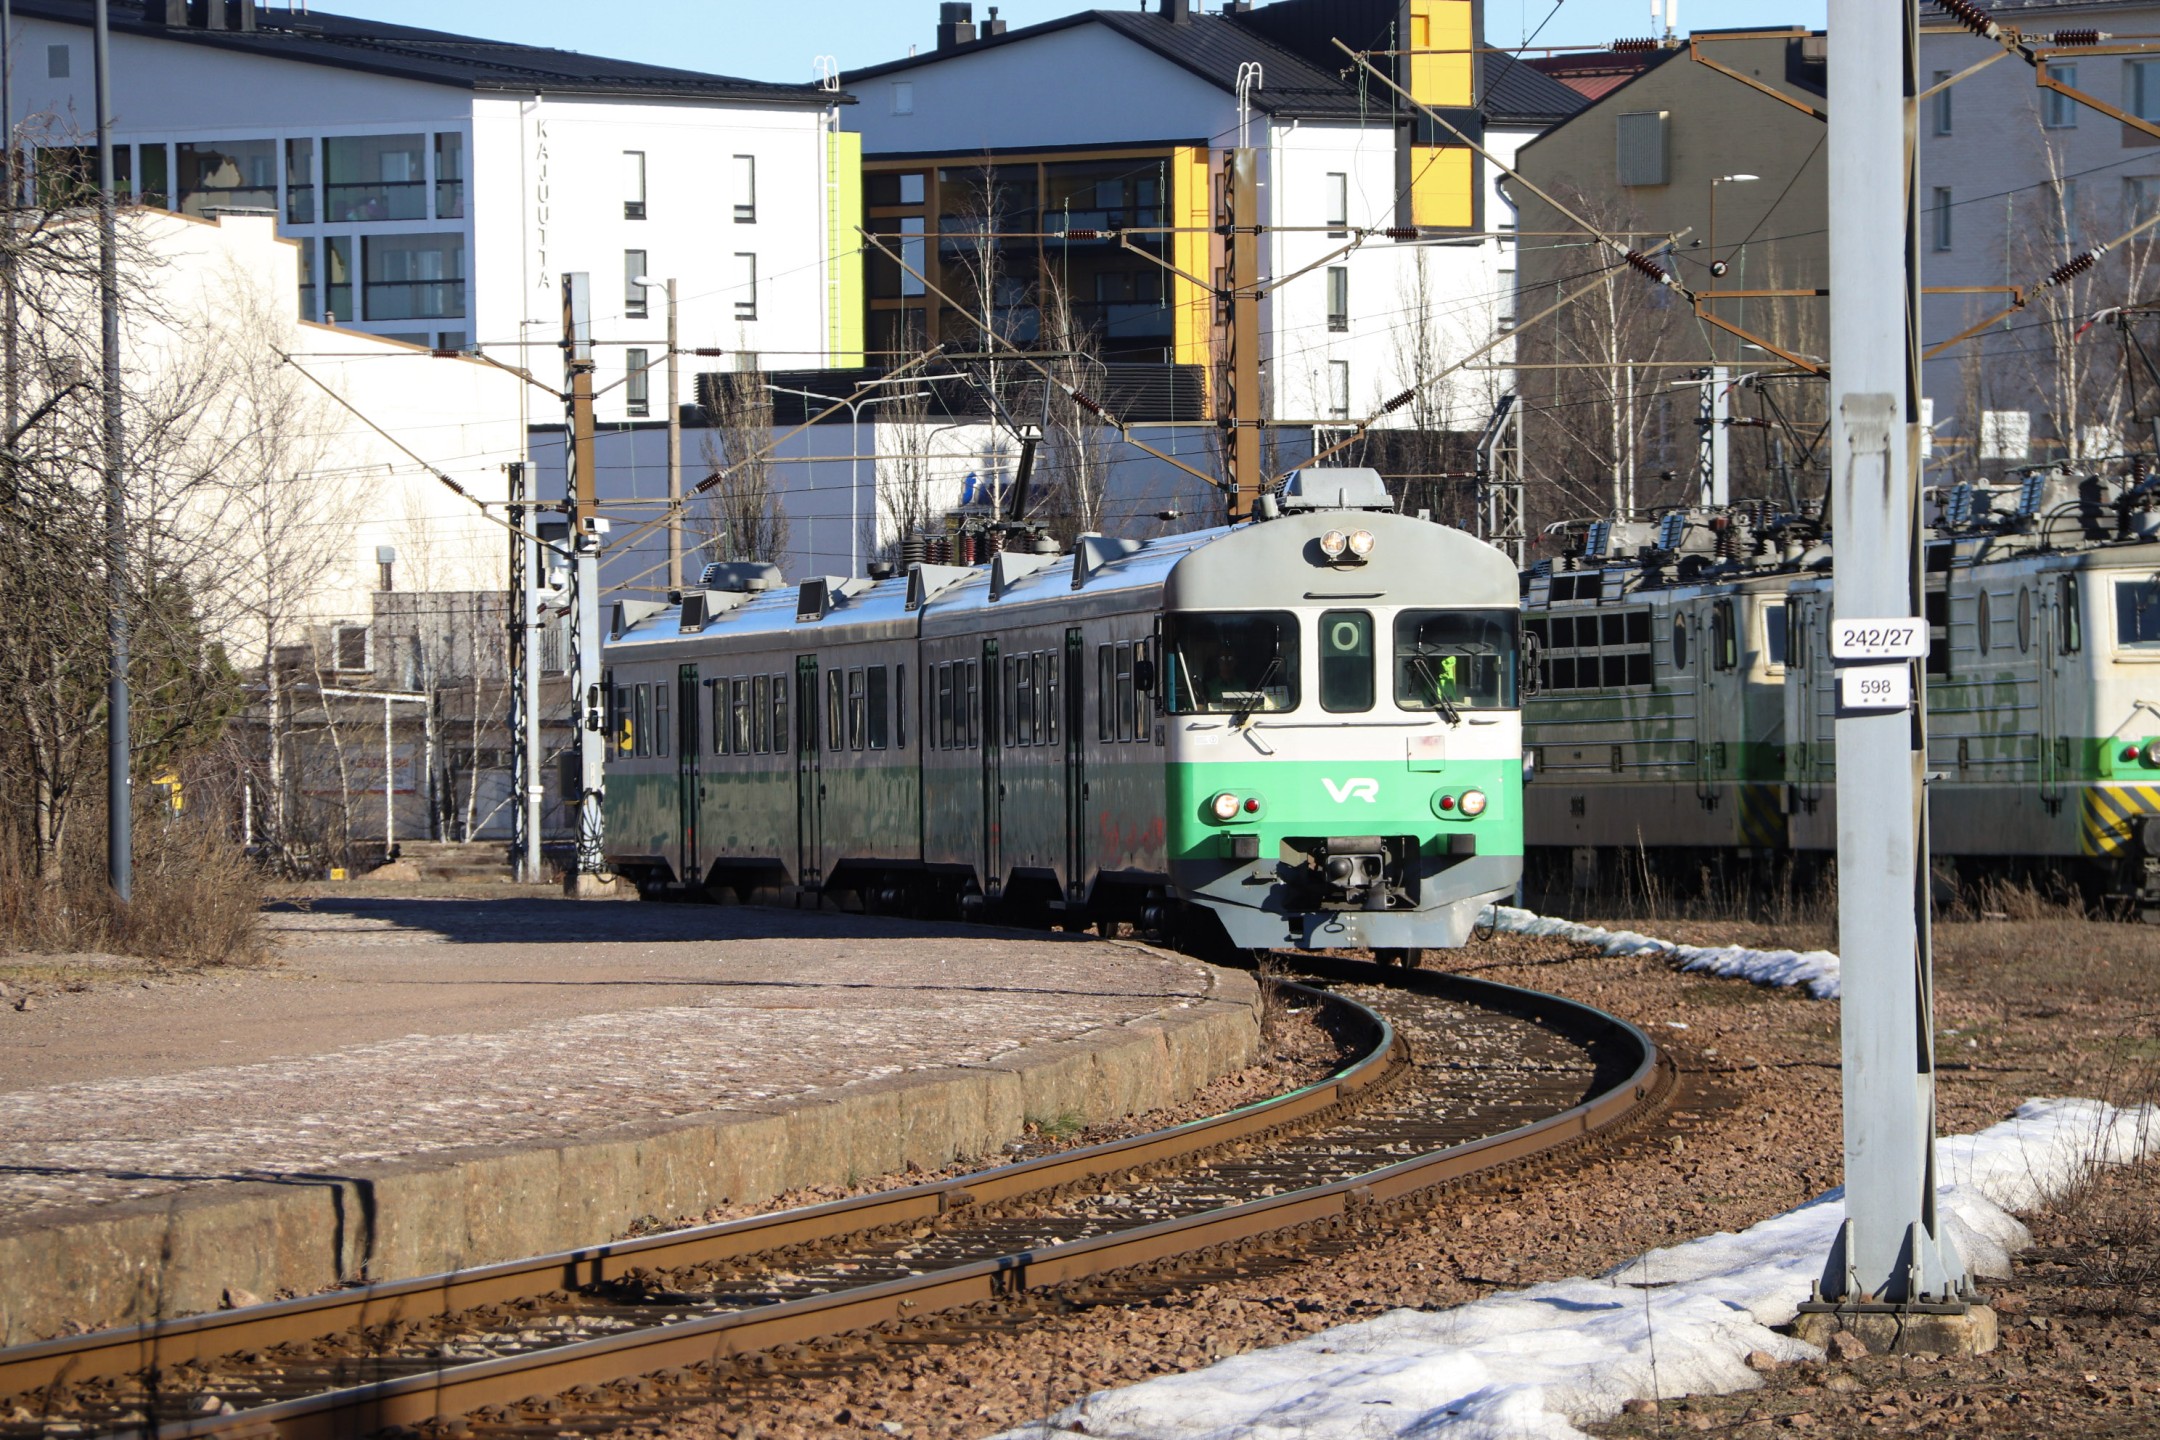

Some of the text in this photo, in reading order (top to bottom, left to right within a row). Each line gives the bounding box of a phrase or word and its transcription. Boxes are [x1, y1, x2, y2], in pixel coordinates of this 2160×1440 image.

[536, 119, 550, 289] KAJUUTTA
[1844, 628, 1914, 647] 242/27
[1861, 680, 1891, 694] 598
[1320, 777, 1379, 804] VR
